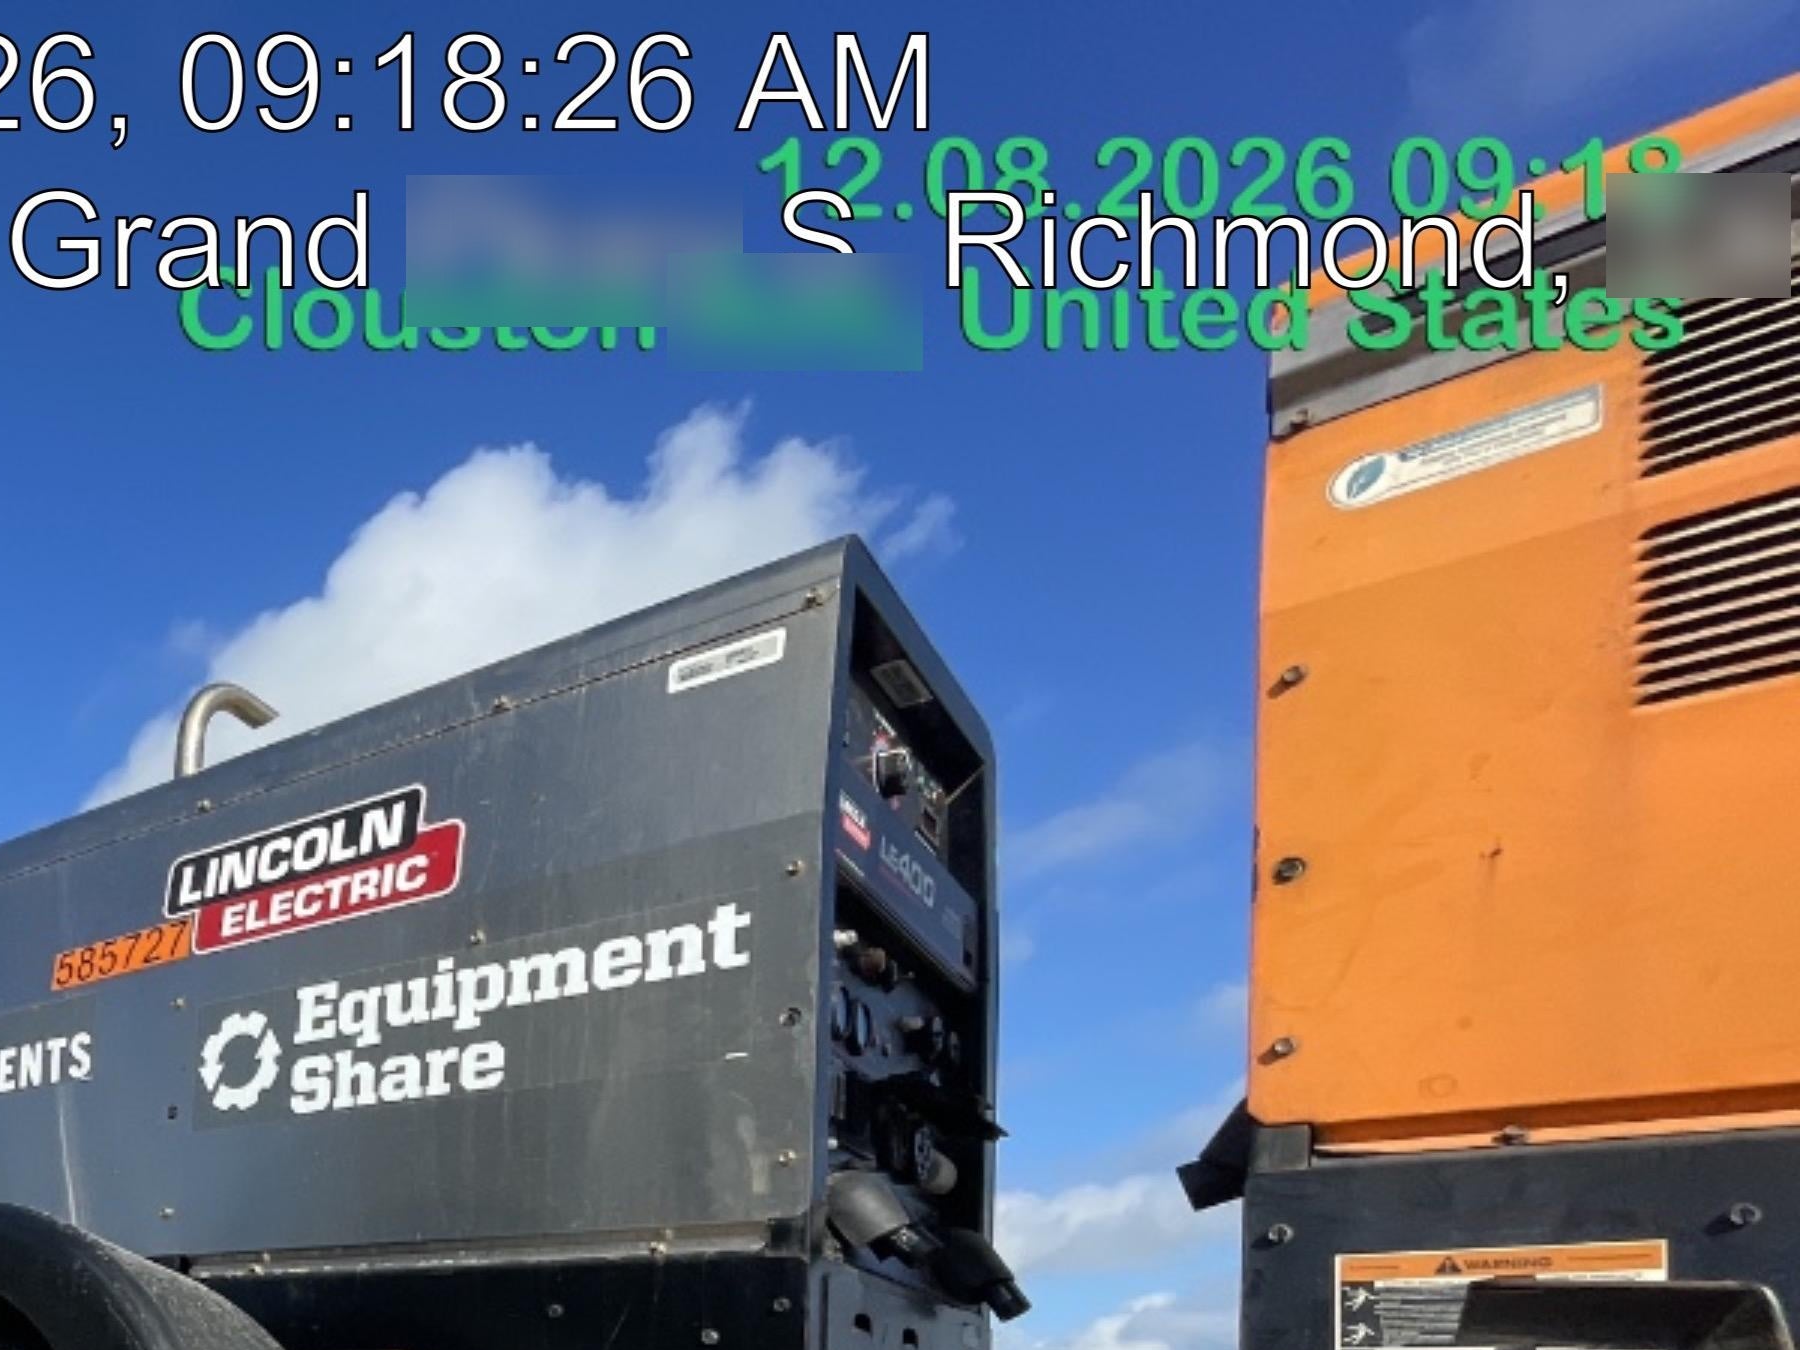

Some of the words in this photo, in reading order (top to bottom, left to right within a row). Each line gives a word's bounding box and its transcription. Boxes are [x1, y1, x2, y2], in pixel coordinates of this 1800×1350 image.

[178, 800, 406, 906] LINCOLN
[220, 853, 430, 938] ELECTRIC
[55, 921, 187, 986] 585727
[293, 902, 752, 1047] Equipment
[290, 1039, 506, 1115] Share
[1463, 1255, 1554, 1271] WARNING
